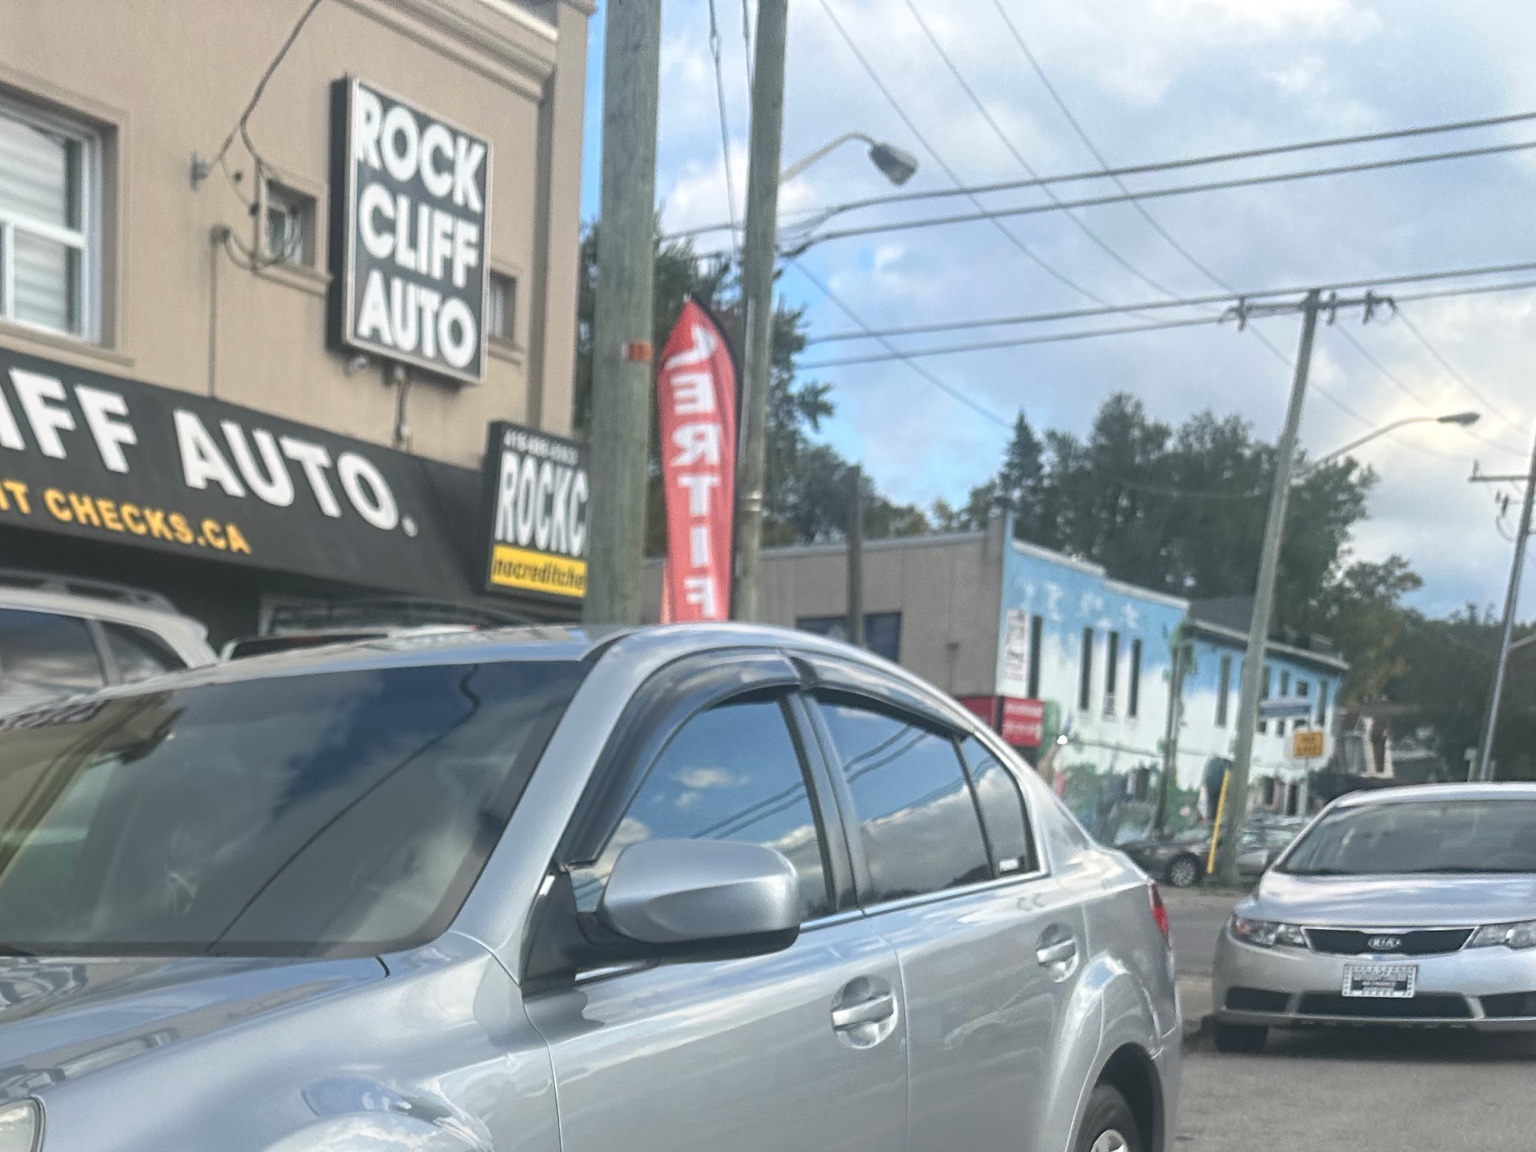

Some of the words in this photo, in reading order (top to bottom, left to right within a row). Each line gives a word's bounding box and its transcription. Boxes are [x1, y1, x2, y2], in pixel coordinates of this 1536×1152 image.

[356, 87, 485, 214] ROCK
[359, 182, 480, 290] CLIFF
[357, 268, 477, 369] AUTO
[43, 486, 252, 556] CHECKS.CA
[172, 408, 419, 538] AUTO.
